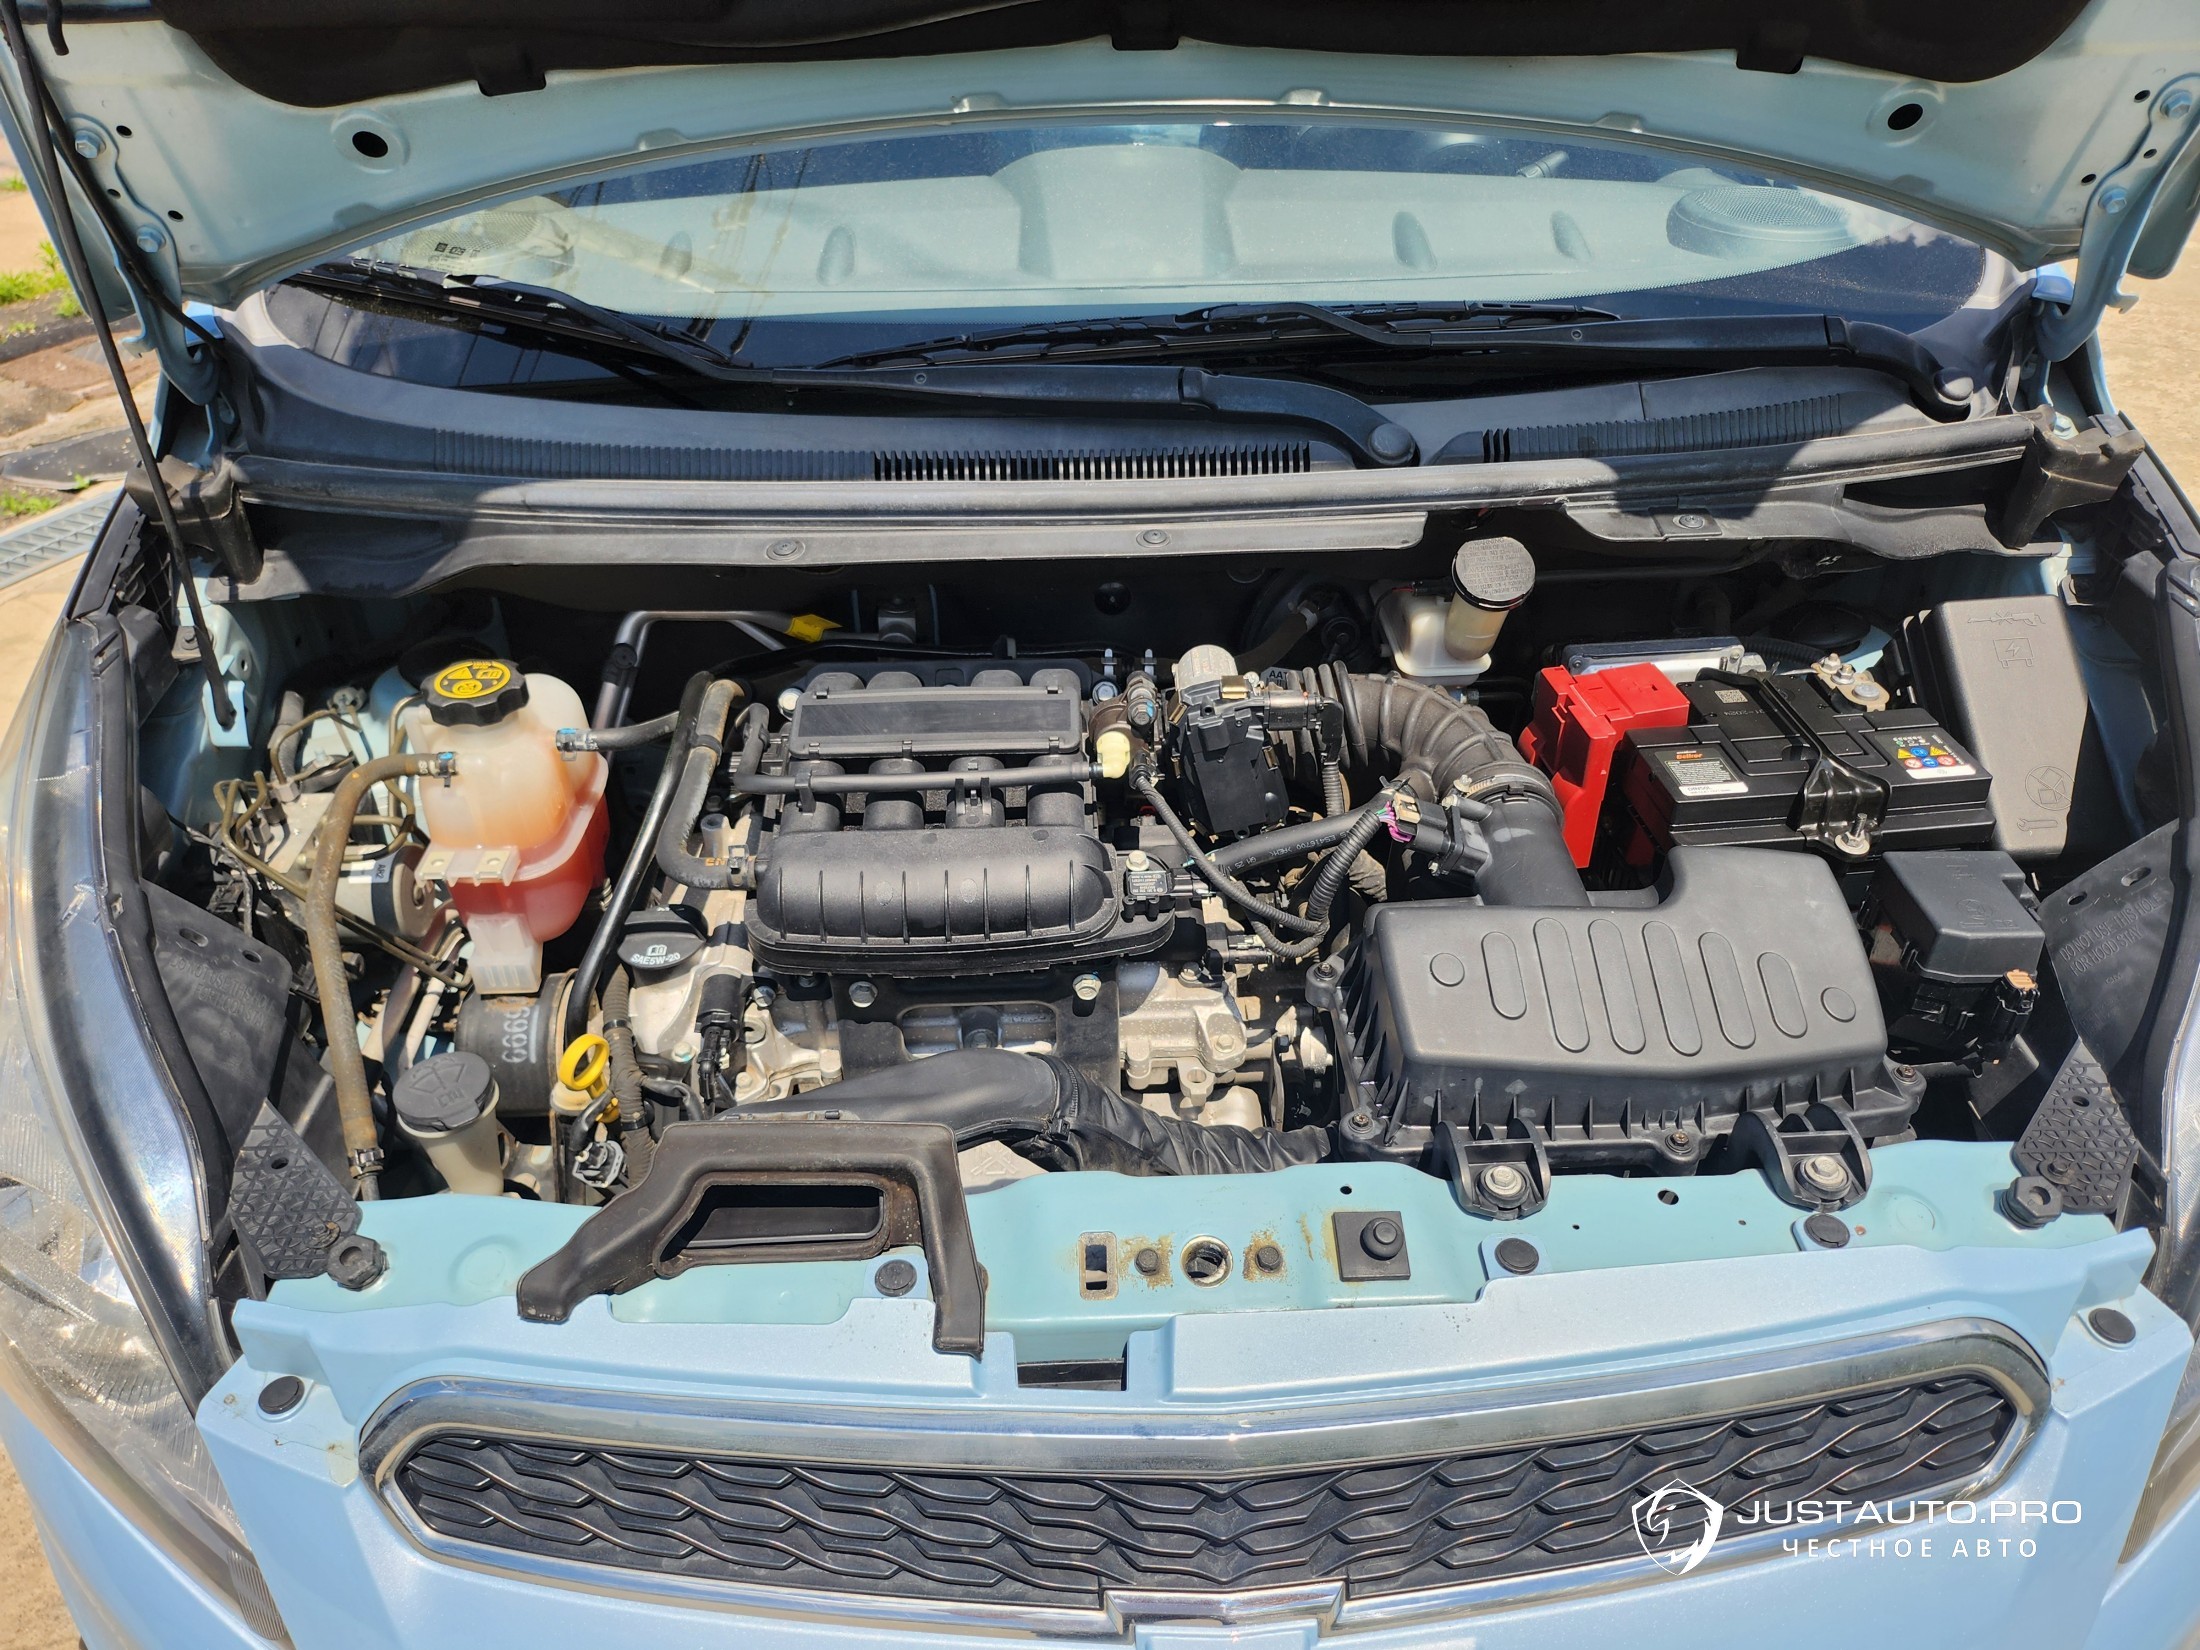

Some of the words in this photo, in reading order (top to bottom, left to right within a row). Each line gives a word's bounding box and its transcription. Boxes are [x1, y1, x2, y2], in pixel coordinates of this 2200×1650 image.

[630, 952, 681, 966] SAE5W-20
[2059, 943, 2077, 961] DO
[2073, 930, 2095, 953] NOT
[2091, 920, 2115, 940] USE
[2112, 906, 2138, 929] THIS
[2069, 955, 2092, 977] FOR
[2088, 938, 2120, 963] HOOD
[2115, 924, 2144, 948] STAY
